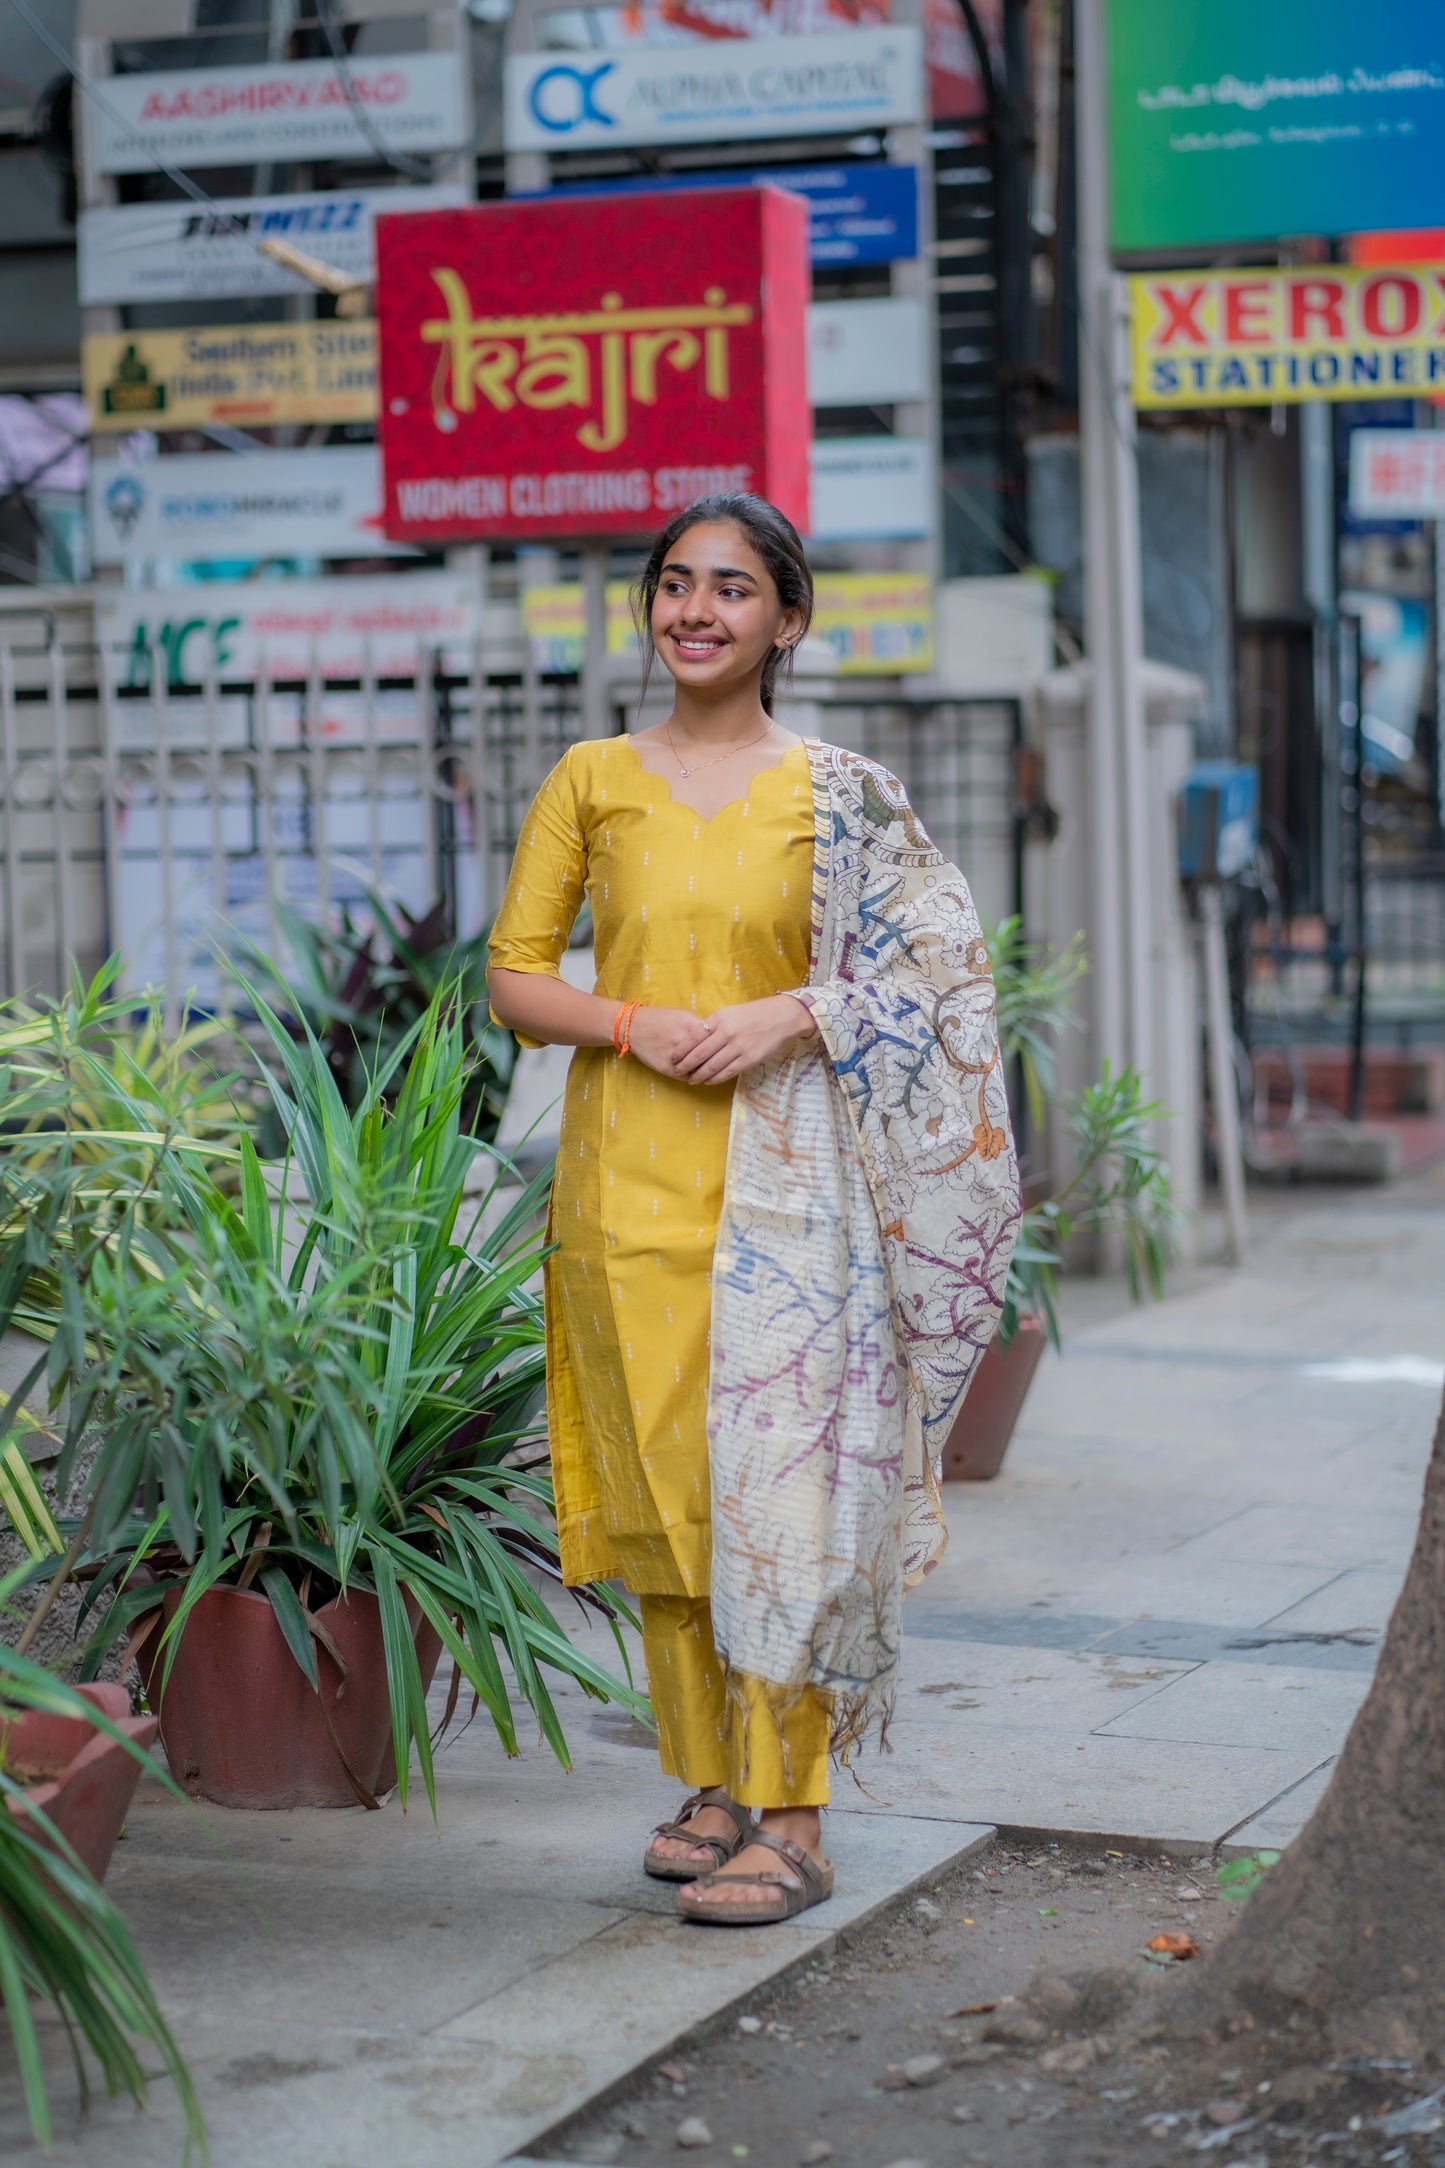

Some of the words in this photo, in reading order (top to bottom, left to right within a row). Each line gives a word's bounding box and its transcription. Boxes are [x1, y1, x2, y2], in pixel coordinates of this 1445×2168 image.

[421, 267, 752, 452] kajri
[397, 479, 506, 523] WOMEN
[511, 470, 650, 519] CLOTHING
[655, 463, 753, 510] STORE
